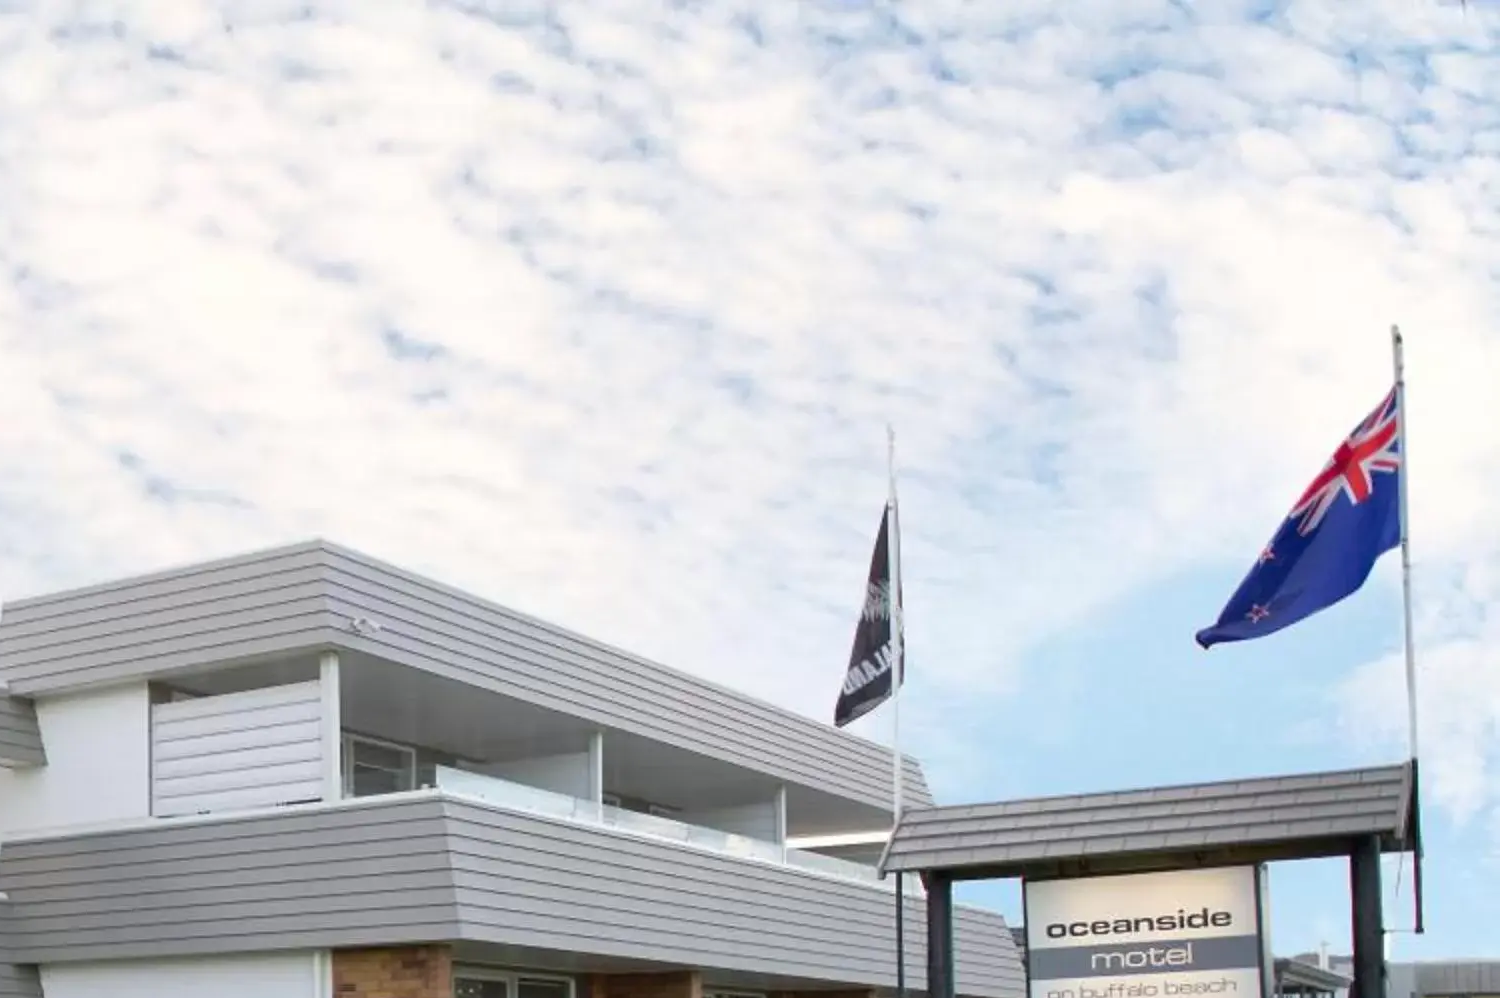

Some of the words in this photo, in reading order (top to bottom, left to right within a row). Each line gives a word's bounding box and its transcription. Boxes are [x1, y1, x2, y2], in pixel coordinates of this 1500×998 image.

[1046, 908, 1232, 939] oceanside
[1091, 942, 1193, 970] motel
[1164, 977, 1238, 996] beach
